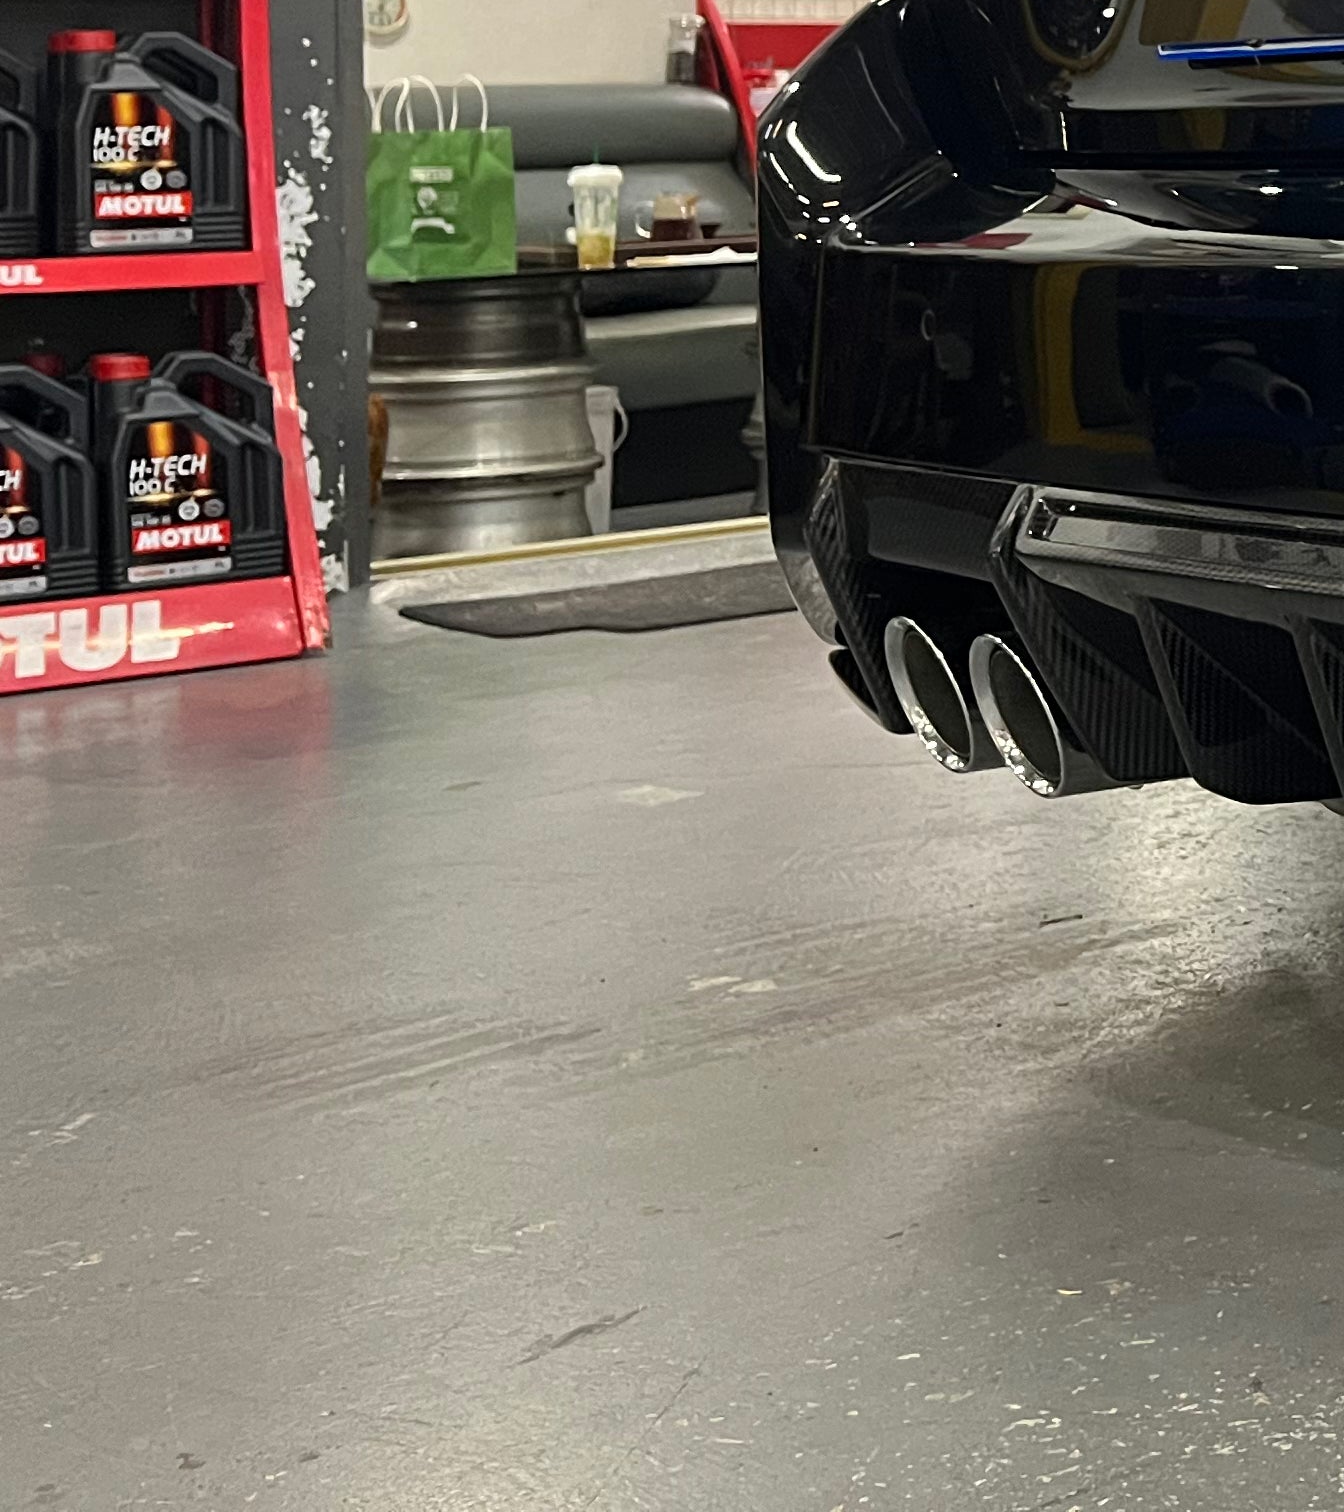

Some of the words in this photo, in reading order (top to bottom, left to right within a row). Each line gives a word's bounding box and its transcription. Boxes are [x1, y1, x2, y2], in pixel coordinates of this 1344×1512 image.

[93, 125, 171, 147] H-TECH
[99, 195, 185, 216] MOTUL
[130, 454, 207, 479] H-TECH
[136, 523, 223, 551] MOTUL
[0, 599, 182, 678] TUL
